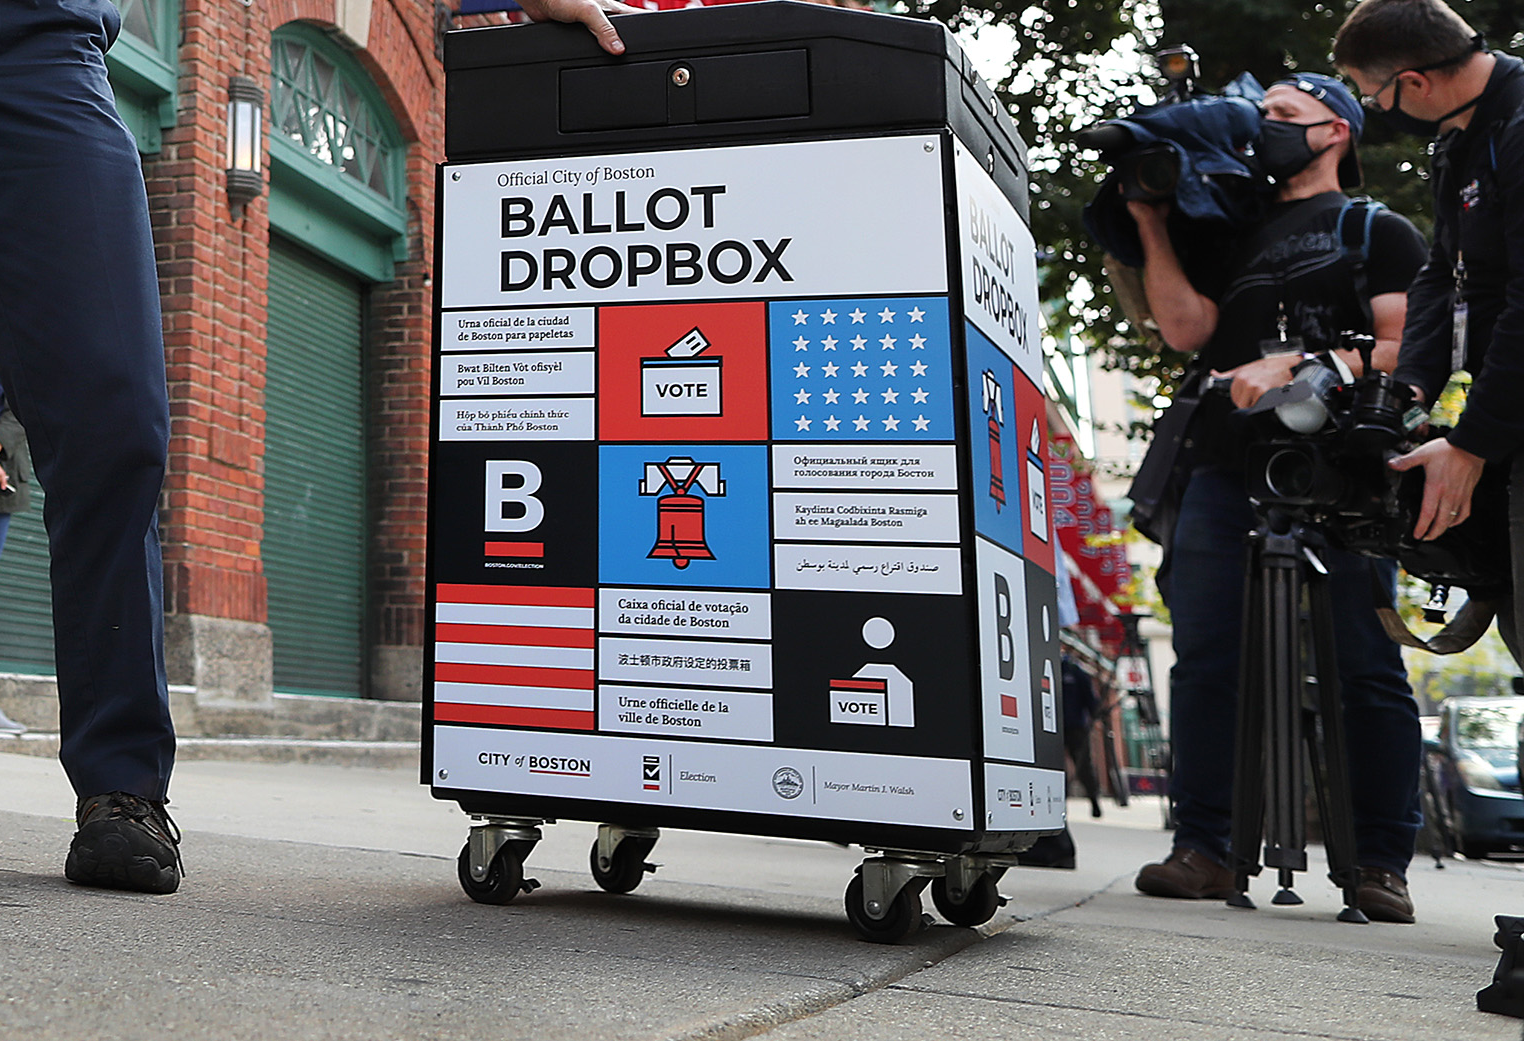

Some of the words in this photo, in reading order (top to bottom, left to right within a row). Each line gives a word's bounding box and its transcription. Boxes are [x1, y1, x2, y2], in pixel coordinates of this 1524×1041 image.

[497, 171, 548, 187] Official
[552, 169, 582, 186] City
[586, 167, 601, 185] of
[604, 166, 655, 181] Boston
[501, 185, 726, 238] BALLOT
[969, 196, 1014, 284] BALLOT
[501, 238, 794, 292] DROPBOX
[972, 255, 1029, 354] DROPBOX
[458, 320, 481, 328] Urna
[483, 318, 511, 327] oficial
[513, 318, 525, 327] de
[527, 317, 535, 326] la
[537, 316, 569, 326] ciudad
[458, 332, 469, 341] de
[471, 331, 503, 340] Boston
[506, 332, 526, 342] para
[529, 330, 574, 341] papeletas
[457, 364, 480, 373] Bwat
[483, 363, 511, 372] Bilten
[457, 378, 474, 388] pou
[477, 377, 489, 385] Vil
[492, 376, 525, 385] Boston
[656, 382, 709, 399] VOTE
[526, 423, 558, 431] Boston
[793, 456, 868, 466] Официальный
[900, 458, 921, 466] для
[794, 469, 858, 477] голосования
[860, 470, 895, 479] города
[897, 469, 935, 478] Бостон
[485, 460, 544, 533] B
[795, 505, 835, 517] Kaydinta
[889, 506, 928, 518] Rasmiga
[821, 518, 868, 528] Magaalada
[870, 518, 903, 527] Boston
[618, 599, 648, 610] Caixa
[651, 600, 685, 612] oficial
[688, 601, 702, 612] de
[705, 603, 749, 616] votação
[618, 614, 631, 625] da
[634, 614, 671, 626] cidade
[673, 616, 687, 627] de
[690, 617, 730, 628] Boston
[994, 572, 1015, 681] B
[618, 697, 647, 708] Urne
[649, 698, 699, 711] officielle
[701, 701, 716, 712] de
[718, 702, 729, 713] la
[839, 700, 878, 716] VOTE
[618, 712, 643, 724] ville
[645, 714, 659, 725] de
[662, 715, 702, 727] Boston
[478, 753, 511, 765] CITY
[515, 755, 526, 768] of
[529, 756, 591, 772] BOSTON
[679, 771, 716, 782] Election
[824, 781, 849, 792] Mayor
[851, 783, 880, 793] Martin
[890, 786, 915, 795] Walsh
